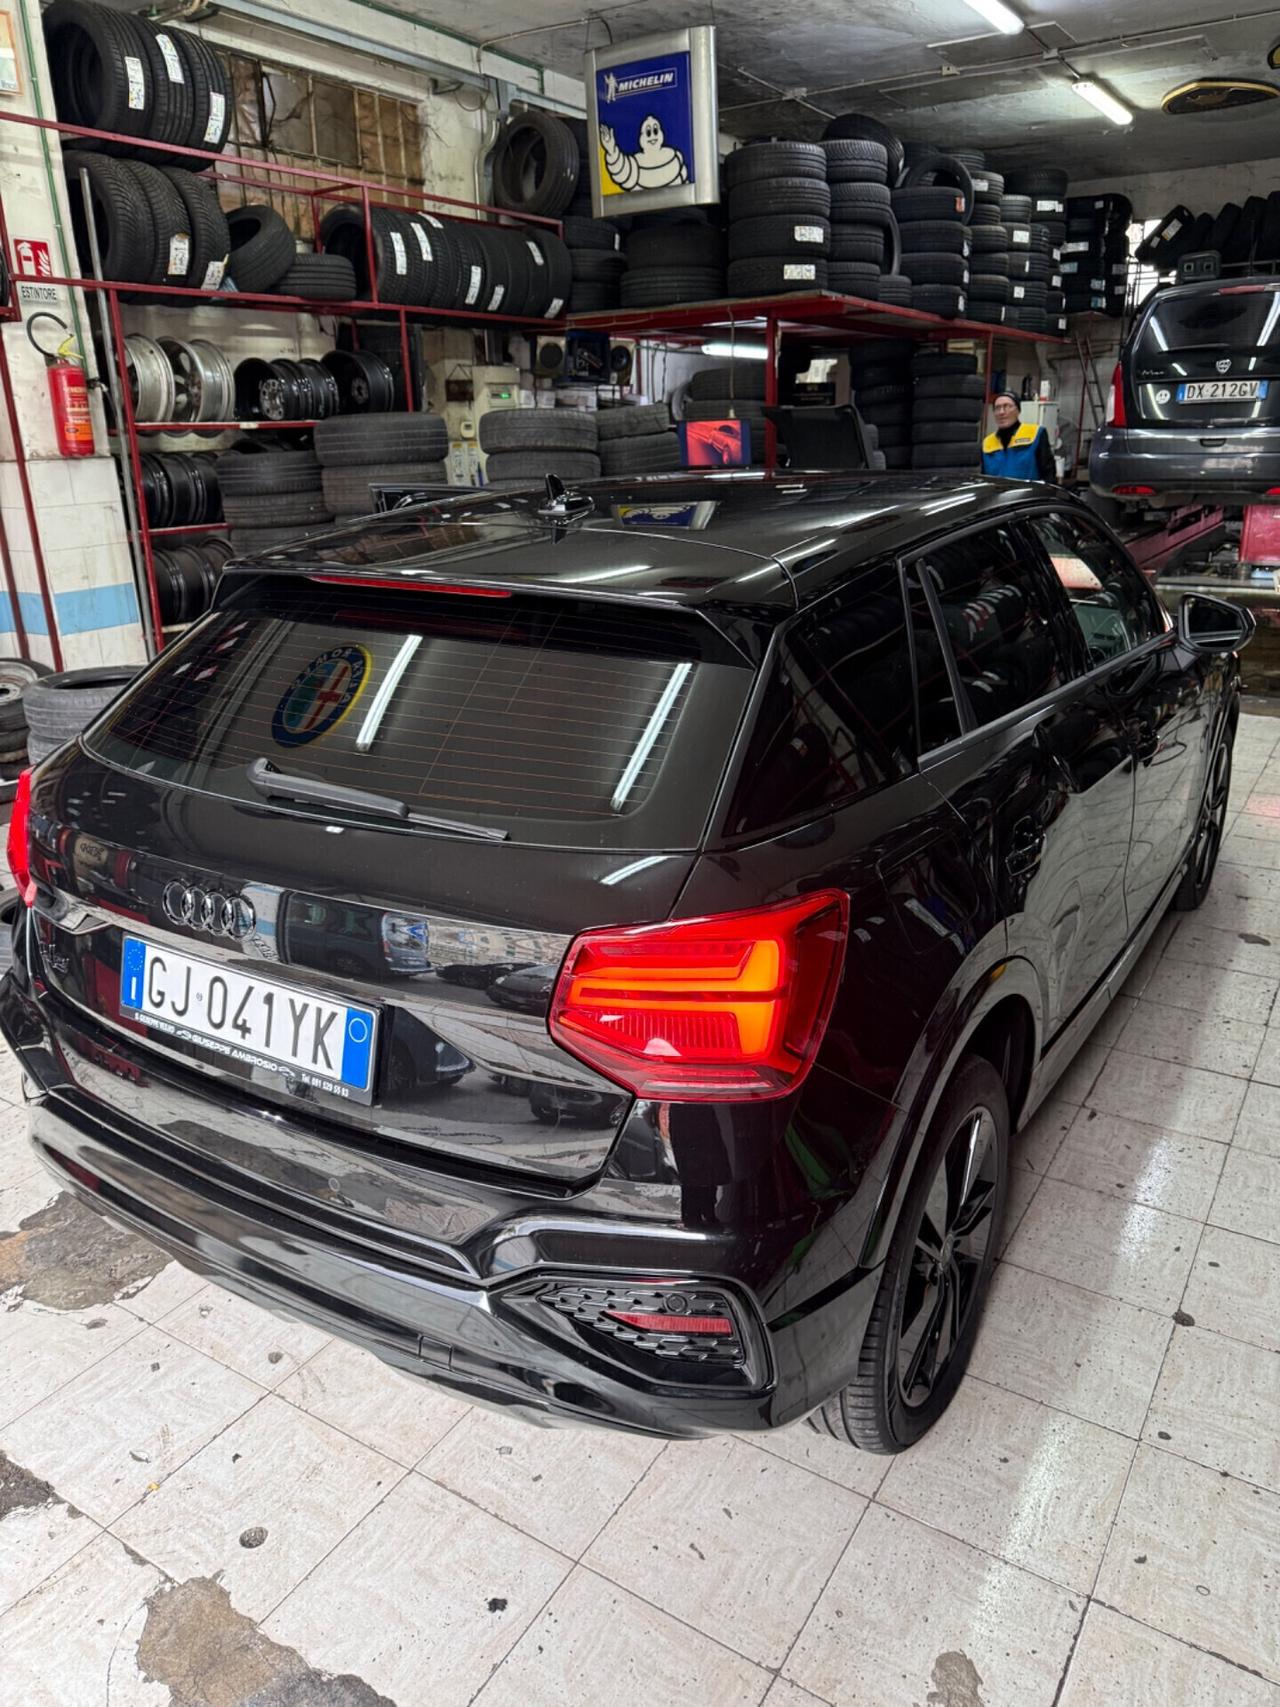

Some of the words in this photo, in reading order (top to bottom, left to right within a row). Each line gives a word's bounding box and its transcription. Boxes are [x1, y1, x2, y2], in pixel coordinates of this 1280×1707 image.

[618, 72, 674, 92] MICHELIN
[21, 286, 57, 301] ESTINTORE
[1187, 384, 1206, 399] DX
[1210, 382, 1259, 398] 212GV
[148, 956, 192, 1017] GJ
[207, 975, 338, 1071] 041YK
[191, 1034, 232, 1054] GIUSEPPE
[231, 1049, 278, 1072] AMBROSIO
